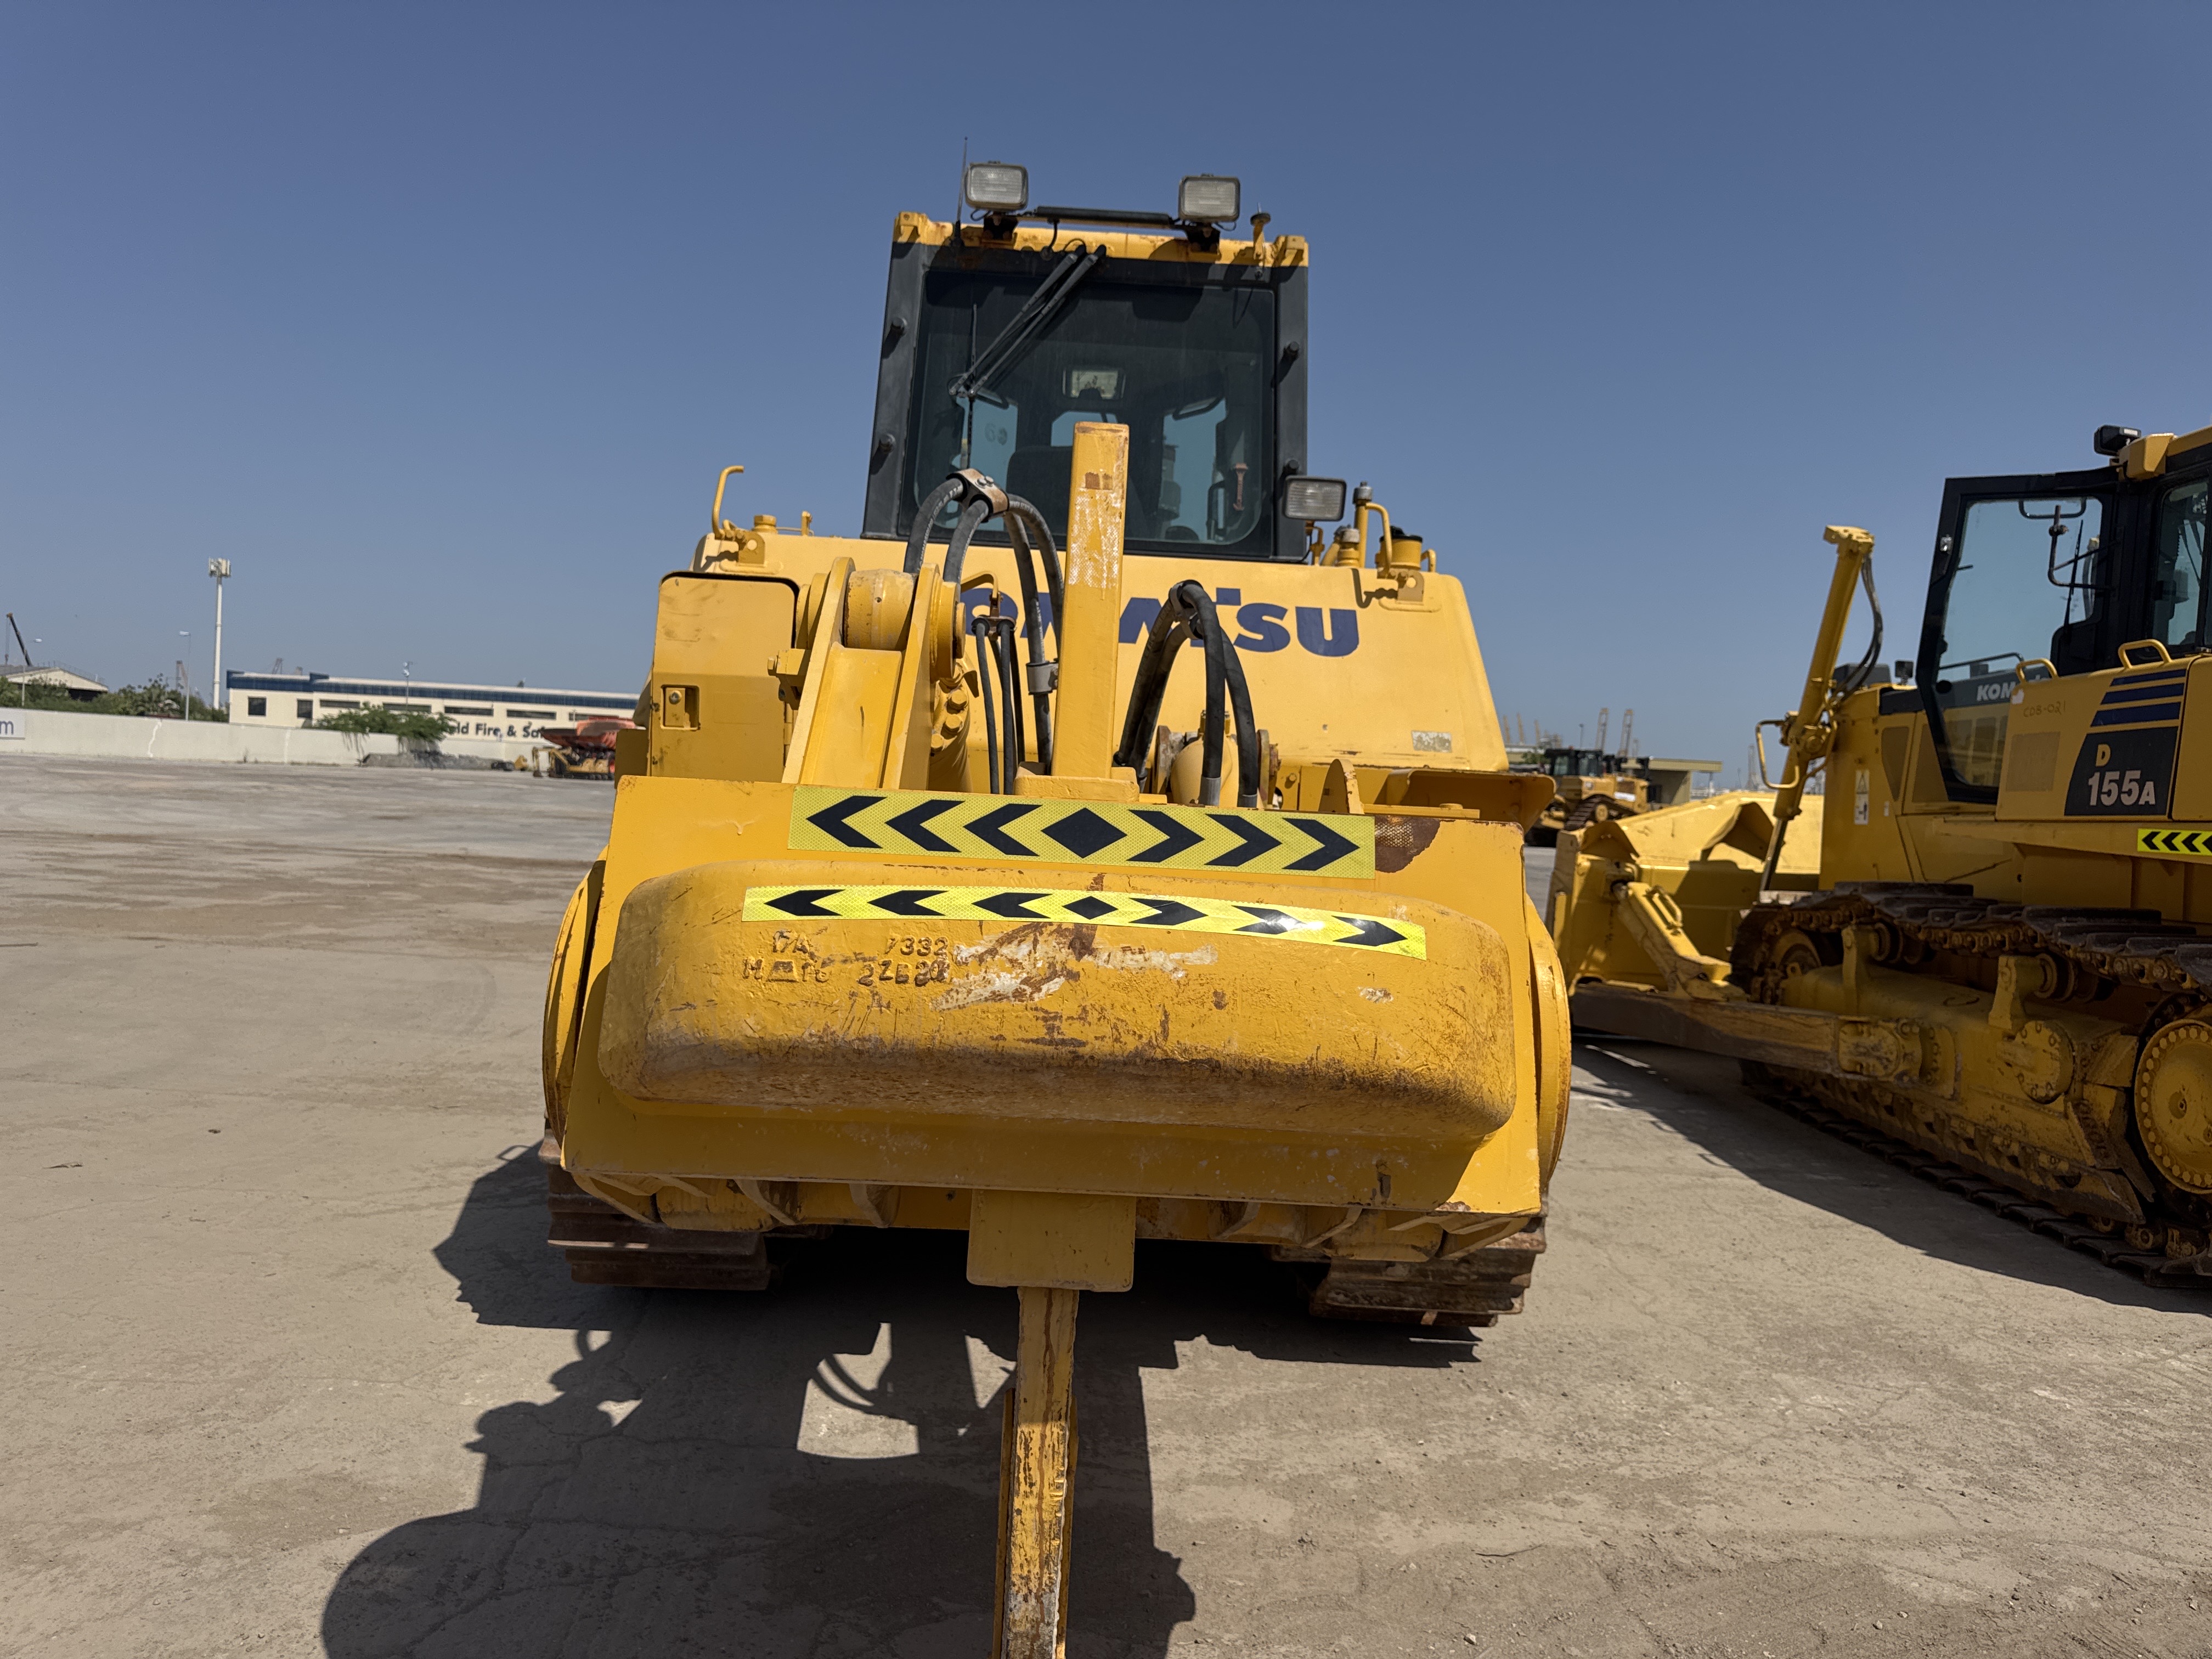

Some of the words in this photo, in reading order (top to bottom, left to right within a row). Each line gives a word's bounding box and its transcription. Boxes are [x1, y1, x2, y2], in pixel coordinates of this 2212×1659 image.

[476, 723, 501, 737] Fire
[507, 724, 516, 737] &
[2096, 744, 2111, 767] D
[2088, 770, 2156, 806] 155A
